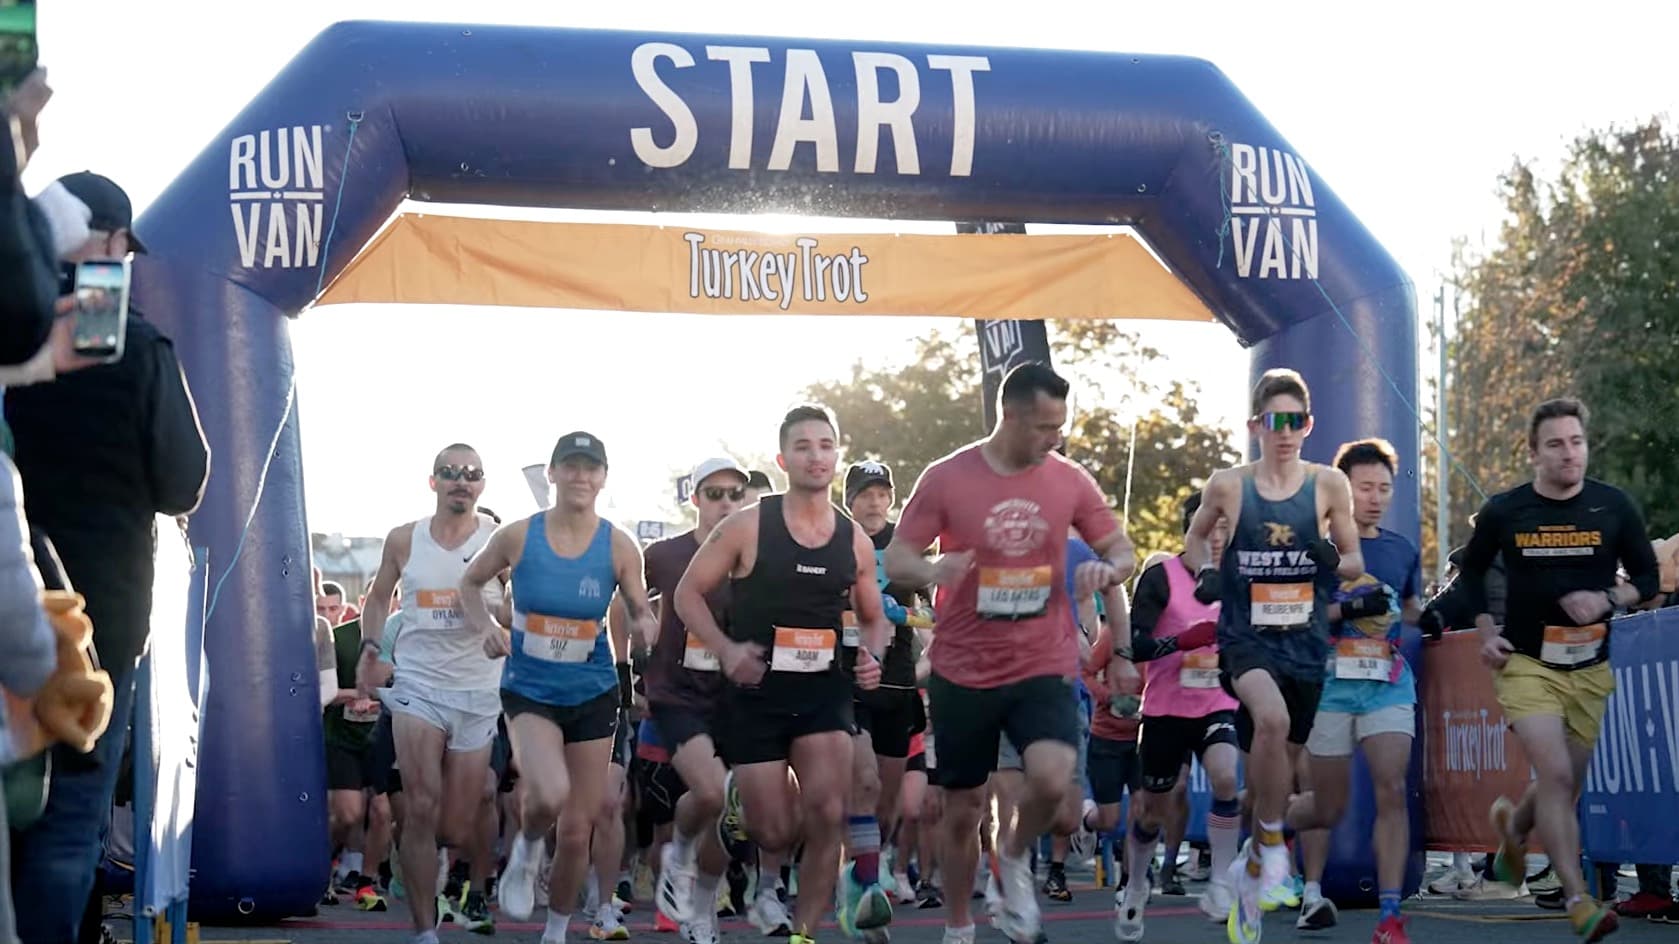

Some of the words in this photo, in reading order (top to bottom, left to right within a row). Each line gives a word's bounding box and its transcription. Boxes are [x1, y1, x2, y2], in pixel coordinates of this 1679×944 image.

[630, 42, 991, 177] START
[229, 125, 324, 190] RUN
[1231, 143, 1315, 207] RUN
[230, 202, 324, 268] VAN
[1231, 217, 1319, 279] VAN
[1238, 551, 1284, 566] WEST
[1286, 551, 1316, 565] VA
[1515, 531, 1603, 547] WARRIORS
[550, 638, 568, 650] SUZ
